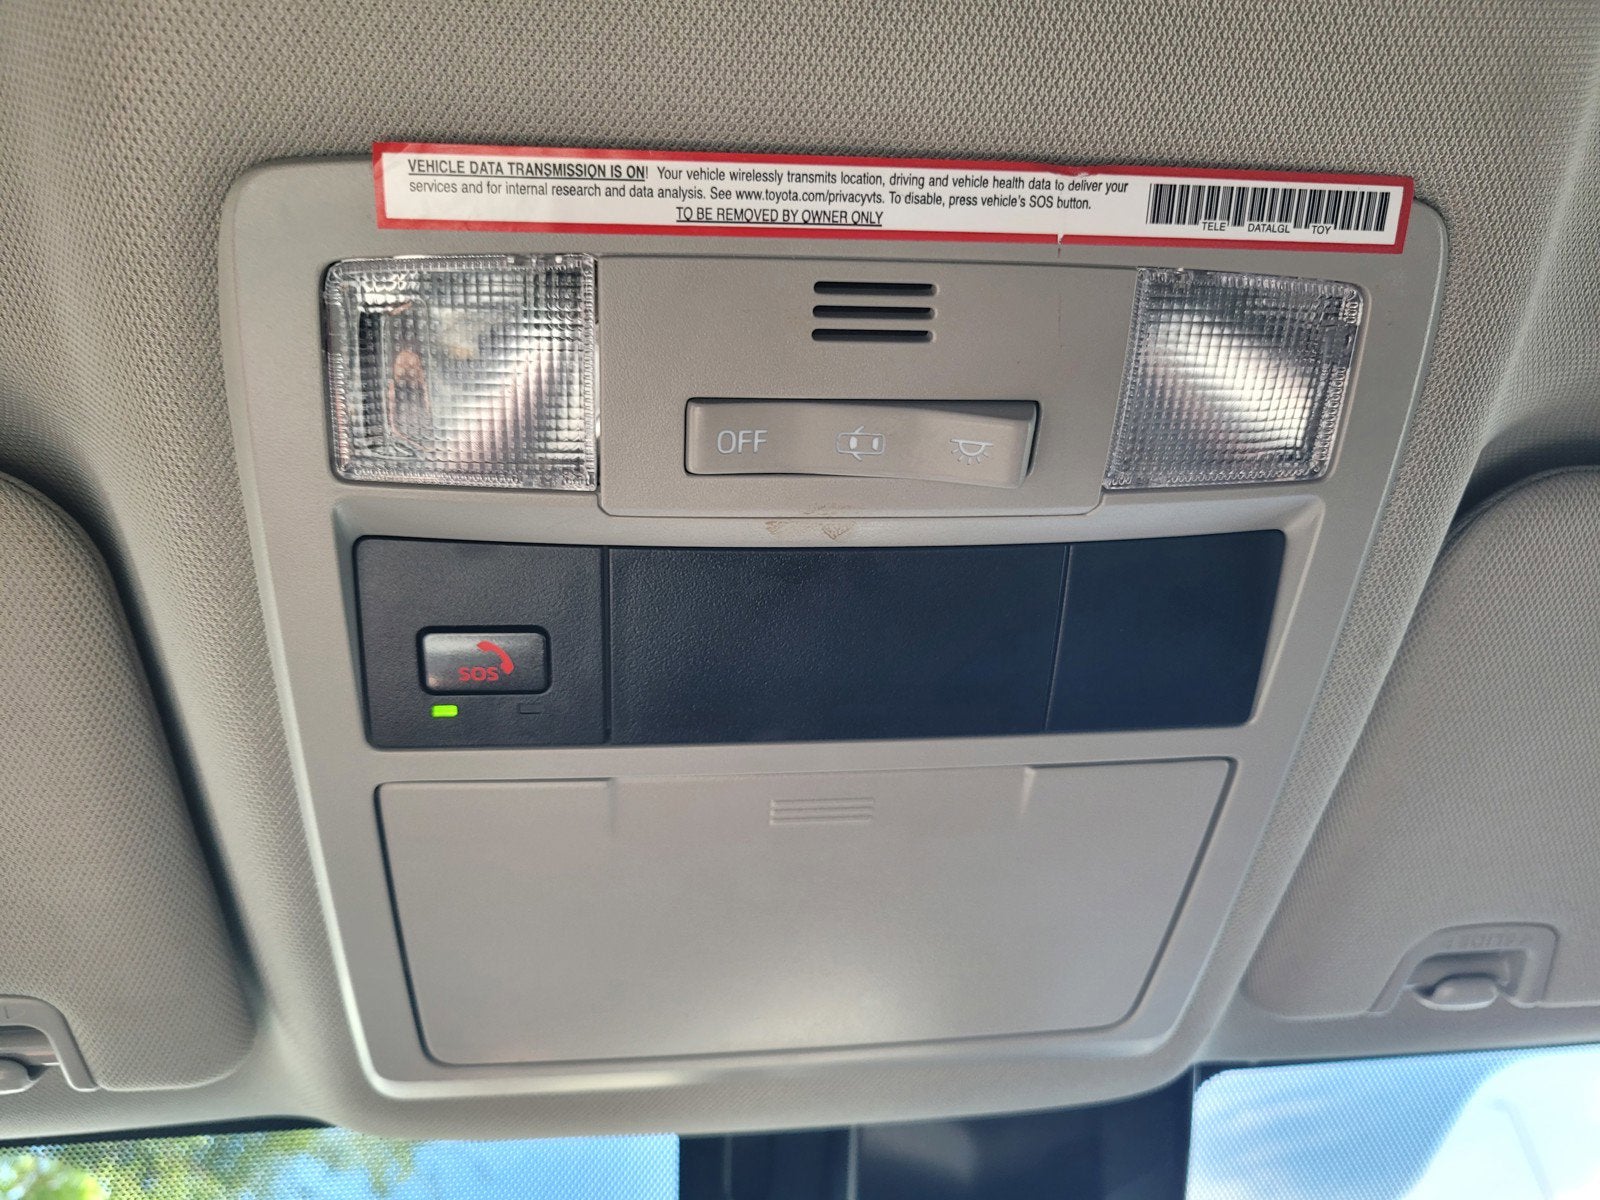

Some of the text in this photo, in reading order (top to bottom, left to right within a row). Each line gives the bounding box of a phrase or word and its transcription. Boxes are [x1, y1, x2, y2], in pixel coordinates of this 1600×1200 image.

[408, 159, 1129, 195] VEHICLE DATA TRANSMISSION IS ON! Your vehicle wirelessly transmits location, driving and vehicle health data to deliver your
[409, 179, 458, 193] services
[461, 181, 483, 195] and
[486, 180, 502, 195] for
[505, 182, 548, 196] internal
[551, 183, 601, 197] research
[604, 185, 626, 198] and
[629, 185, 654, 198] data
[657, 186, 706, 202] analysis.
[709, 186, 732, 200] See
[889, 190, 901, 204] To
[904, 192, 945, 207] disable,
[948, 195, 978, 209] press
[981, 195, 1026, 208] vehicle's
[1029, 195, 1054, 209] SOS
[1056, 197, 1092, 210] button.
[676, 206, 884, 226] TO BE REMOVED BY OWNER ONLY
[1202, 221, 1332, 235] TELE DATALGL TOY
[717, 430, 768, 454] OFF
[458, 666, 499, 682] SOS
